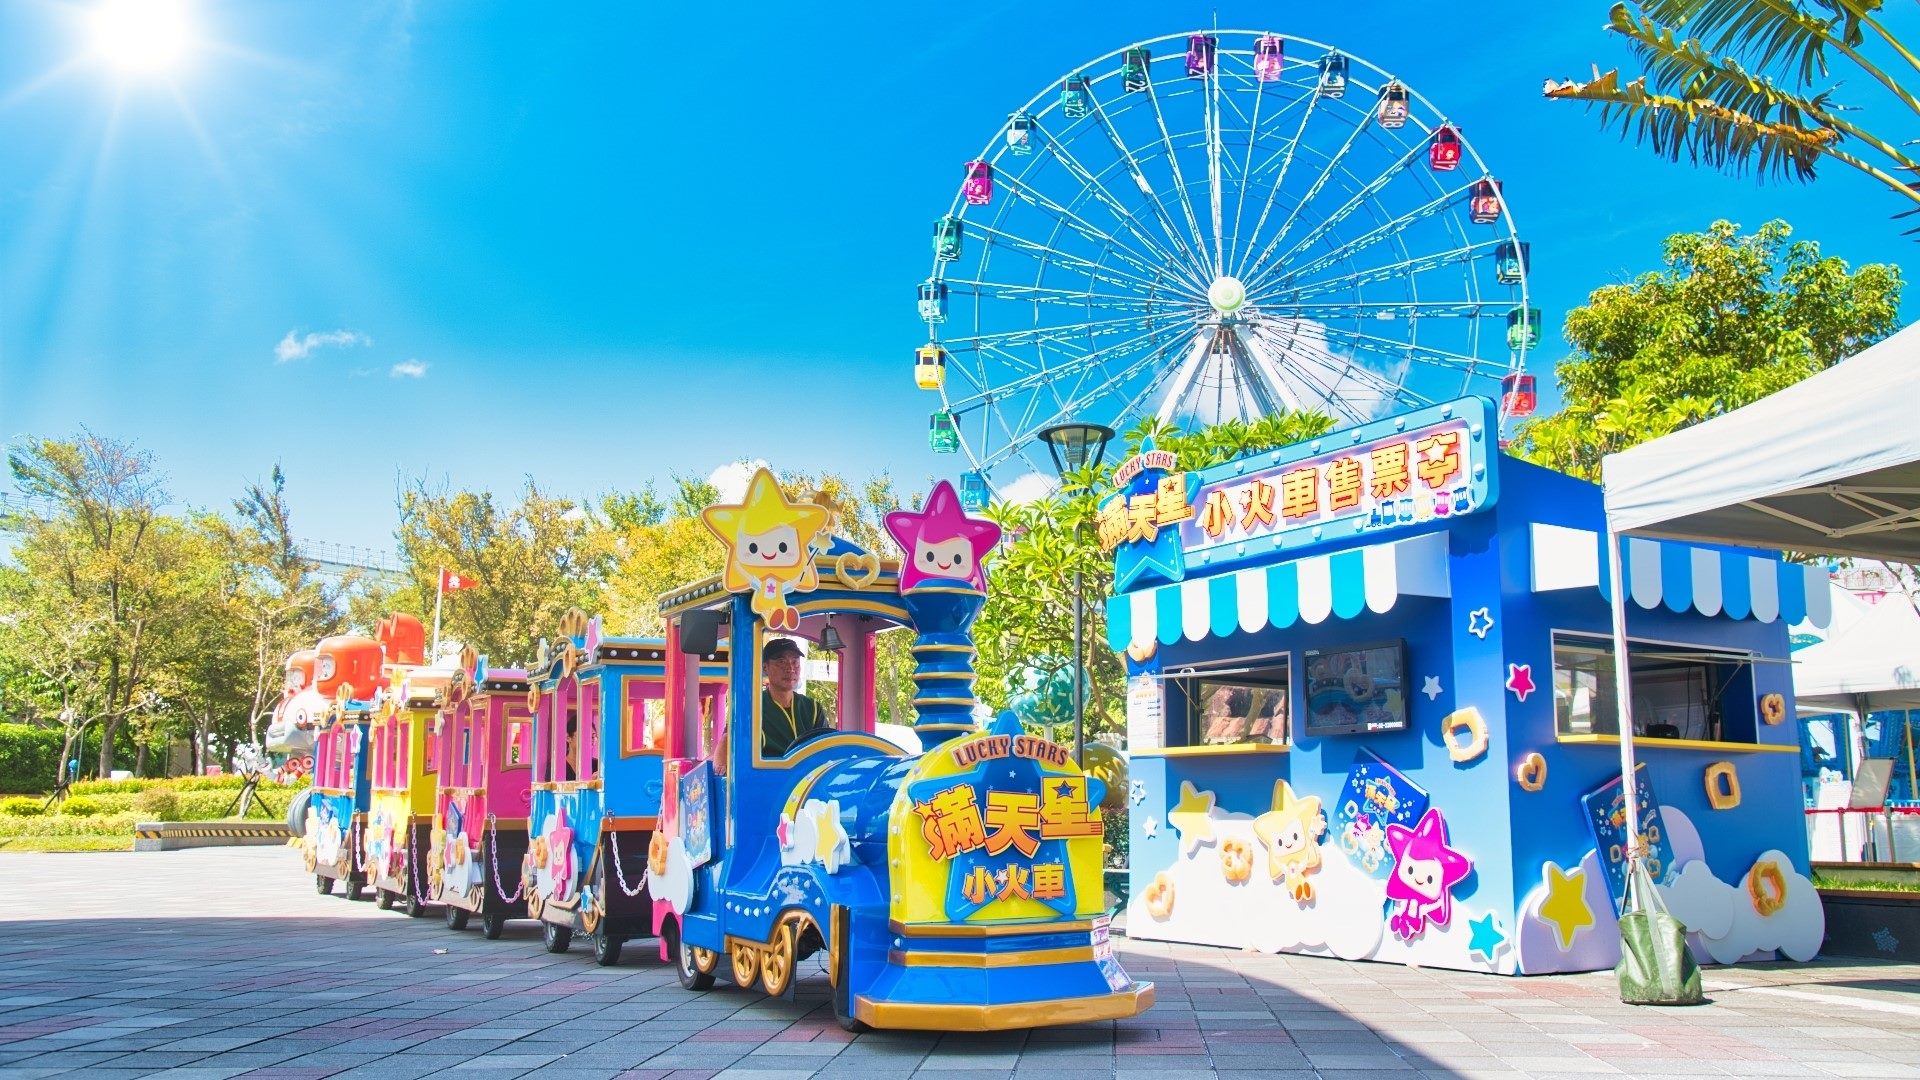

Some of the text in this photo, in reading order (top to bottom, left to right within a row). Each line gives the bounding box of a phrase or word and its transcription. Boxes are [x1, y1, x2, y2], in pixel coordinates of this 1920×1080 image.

[1125, 80, 1146, 93] 22
[1064, 106, 1085, 118] 23
[1382, 117, 1406, 128] 18
[1433, 160, 1458, 170] 17
[1474, 214, 1499, 224] 16
[1115, 454, 1174, 486] LUCKY STARS
[1203, 431, 1462, 537] 小火車售票亭
[1094, 472, 1194, 552] 滿天星
[955, 736, 1068, 766] LUCKY STARS
[913, 776, 1104, 861] 滿天星
[963, 863, 1066, 904] 小火車
